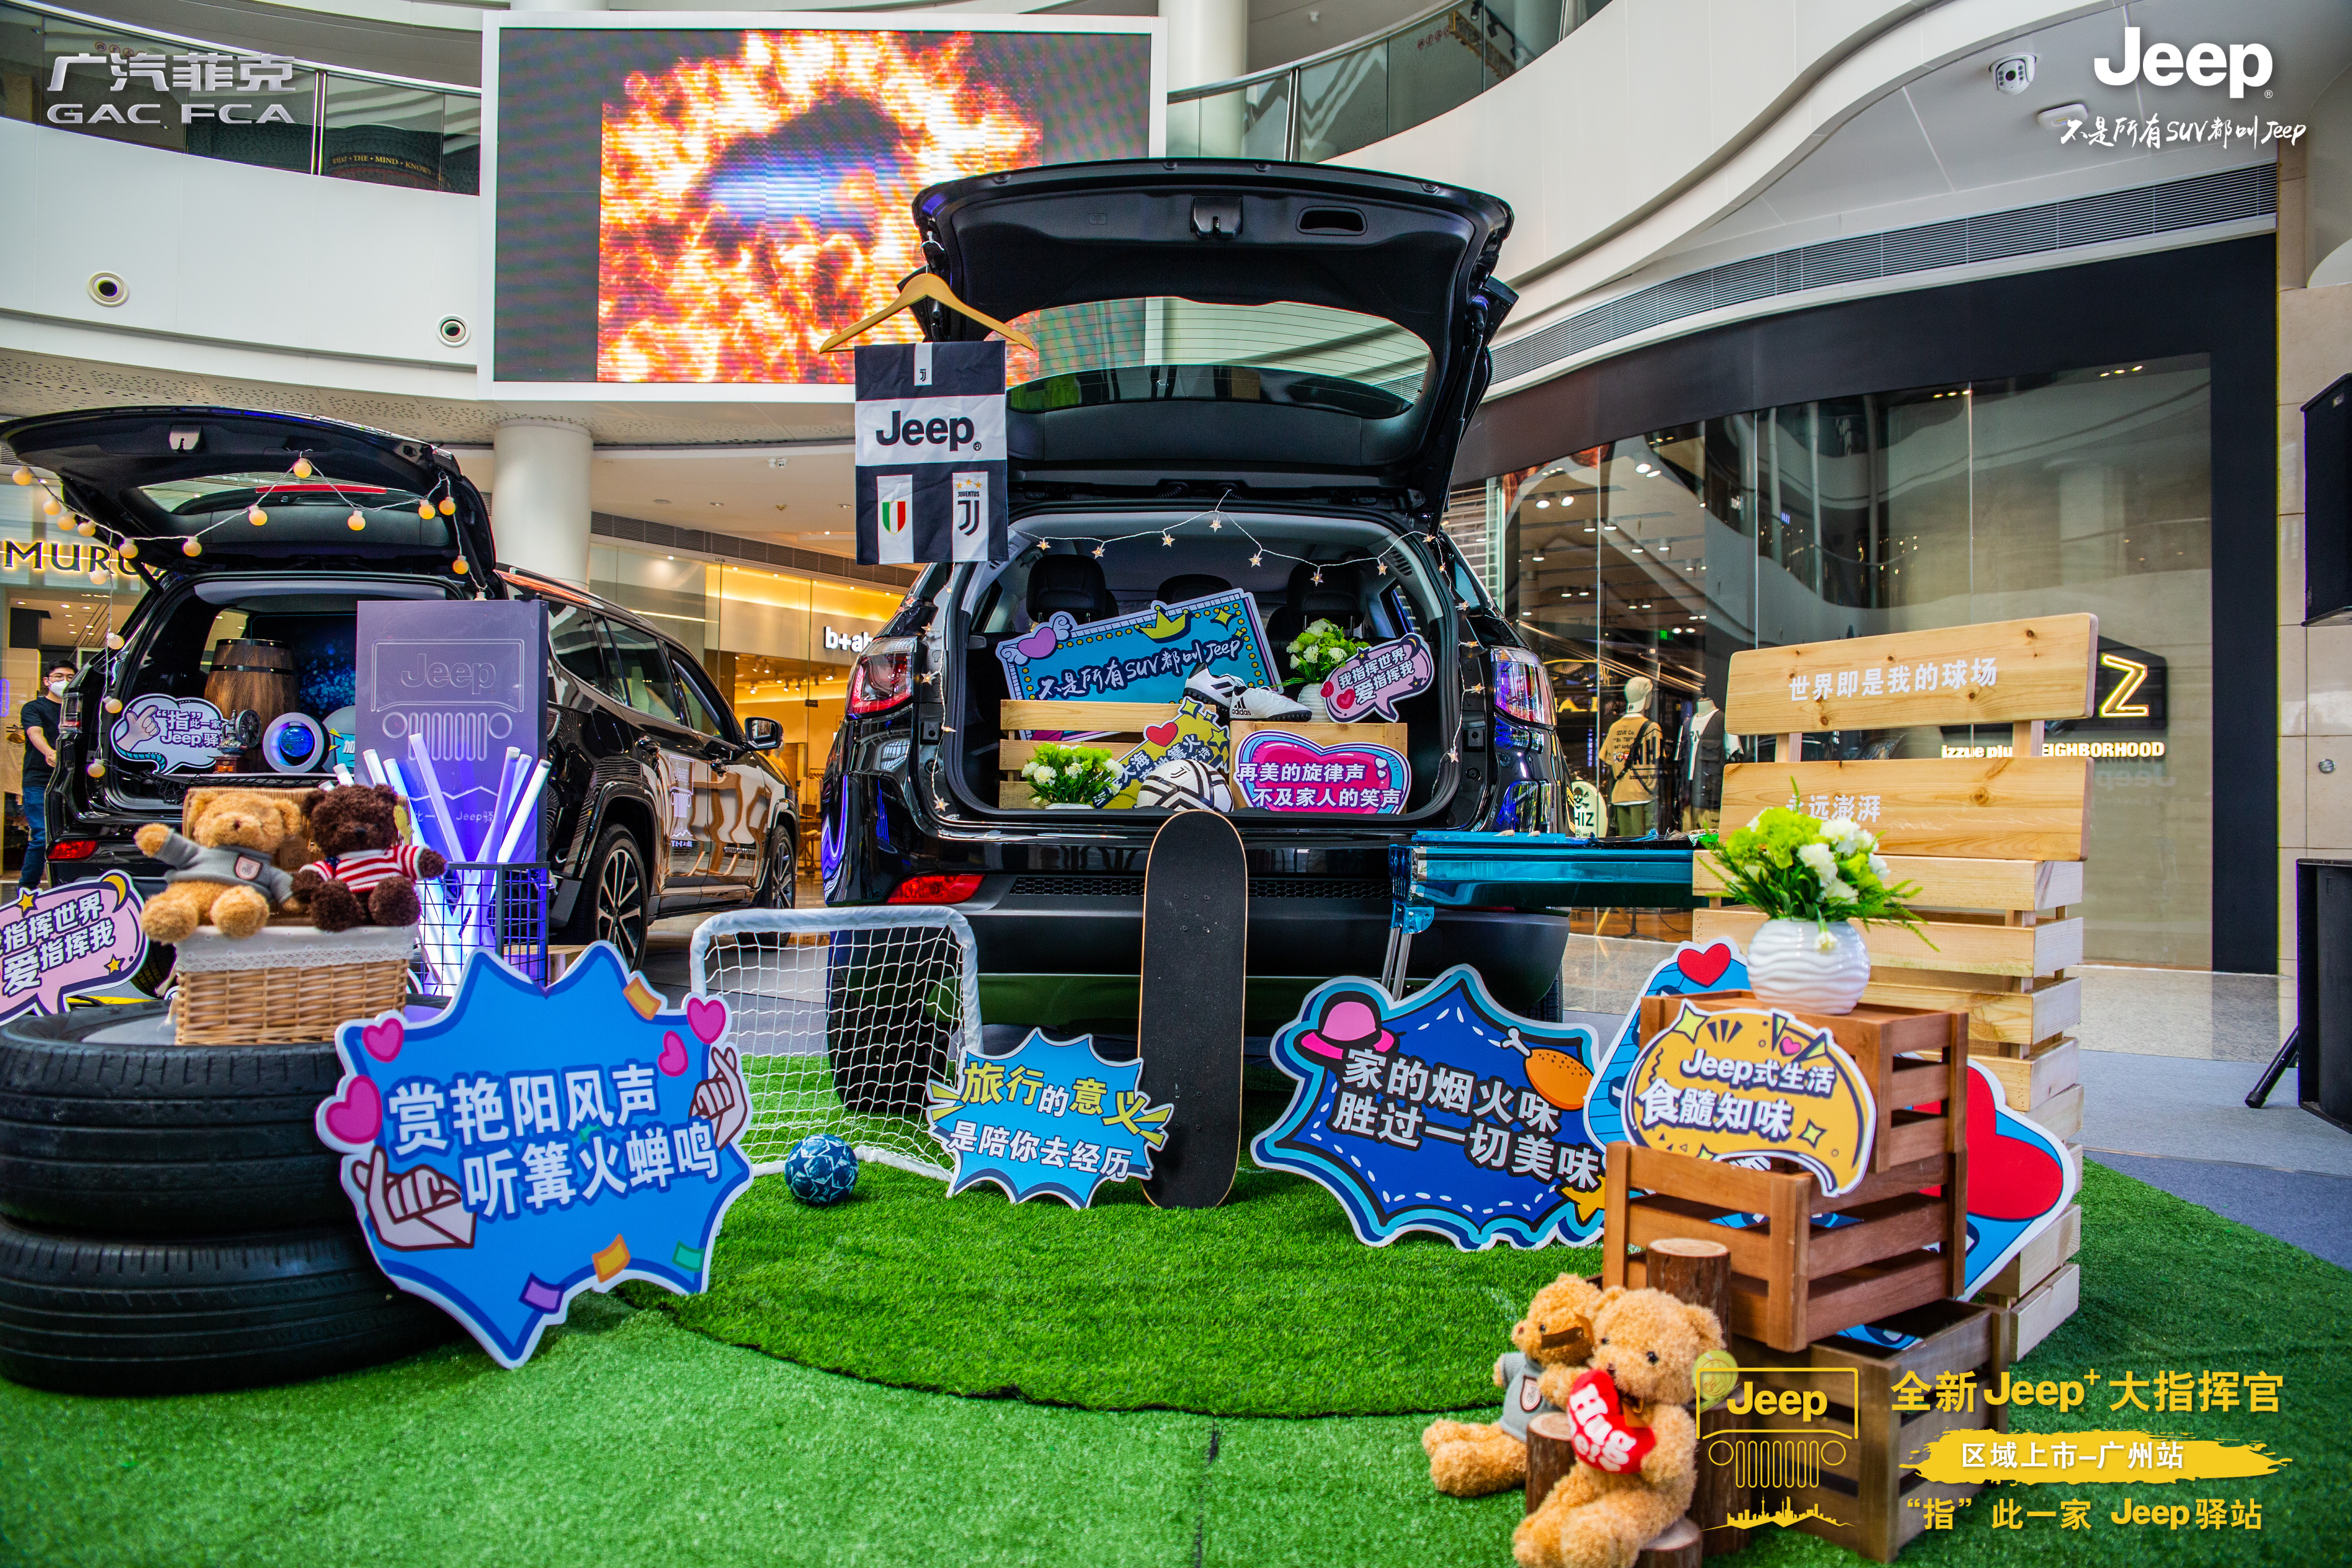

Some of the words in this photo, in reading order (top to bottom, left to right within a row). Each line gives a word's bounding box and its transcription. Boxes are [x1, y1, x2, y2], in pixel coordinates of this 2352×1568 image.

[375, 156, 399, 165] MIND
[876, 410, 975, 452] Jeep
[401, 653, 496, 695] Jeep
[1339, 647, 1407, 689] 我指挥世界
[1354, 661, 1415, 705] 爱指挥我
[1789, 657, 1998, 702] 世界即是我的球场
[1232, 708, 1252, 716] adidas
[1237, 763, 1365, 782] 再美的旋律声
[1941, 745, 1985, 758] izzue
[1252, 788, 1402, 808] 不及家人的笑声
[0, 892, 102, 956] 指挥世界
[3, 919, 115, 996] 爱指挥我
[1345, 1048, 1560, 1134] 家的烟火味
[1680, 1049, 1836, 1096] Jeep式生活
[388, 1064, 657, 1155] 赏艳阳风声
[962, 1061, 1141, 1136] 旅行的意义
[1637, 1078, 1793, 1139] 食髓知味
[947, 1120, 1133, 1183] 是陪你去经历
[1332, 1091, 1601, 1190] 胜过一切美味
[463, 1121, 721, 1218] 听篝火蝉鸣
